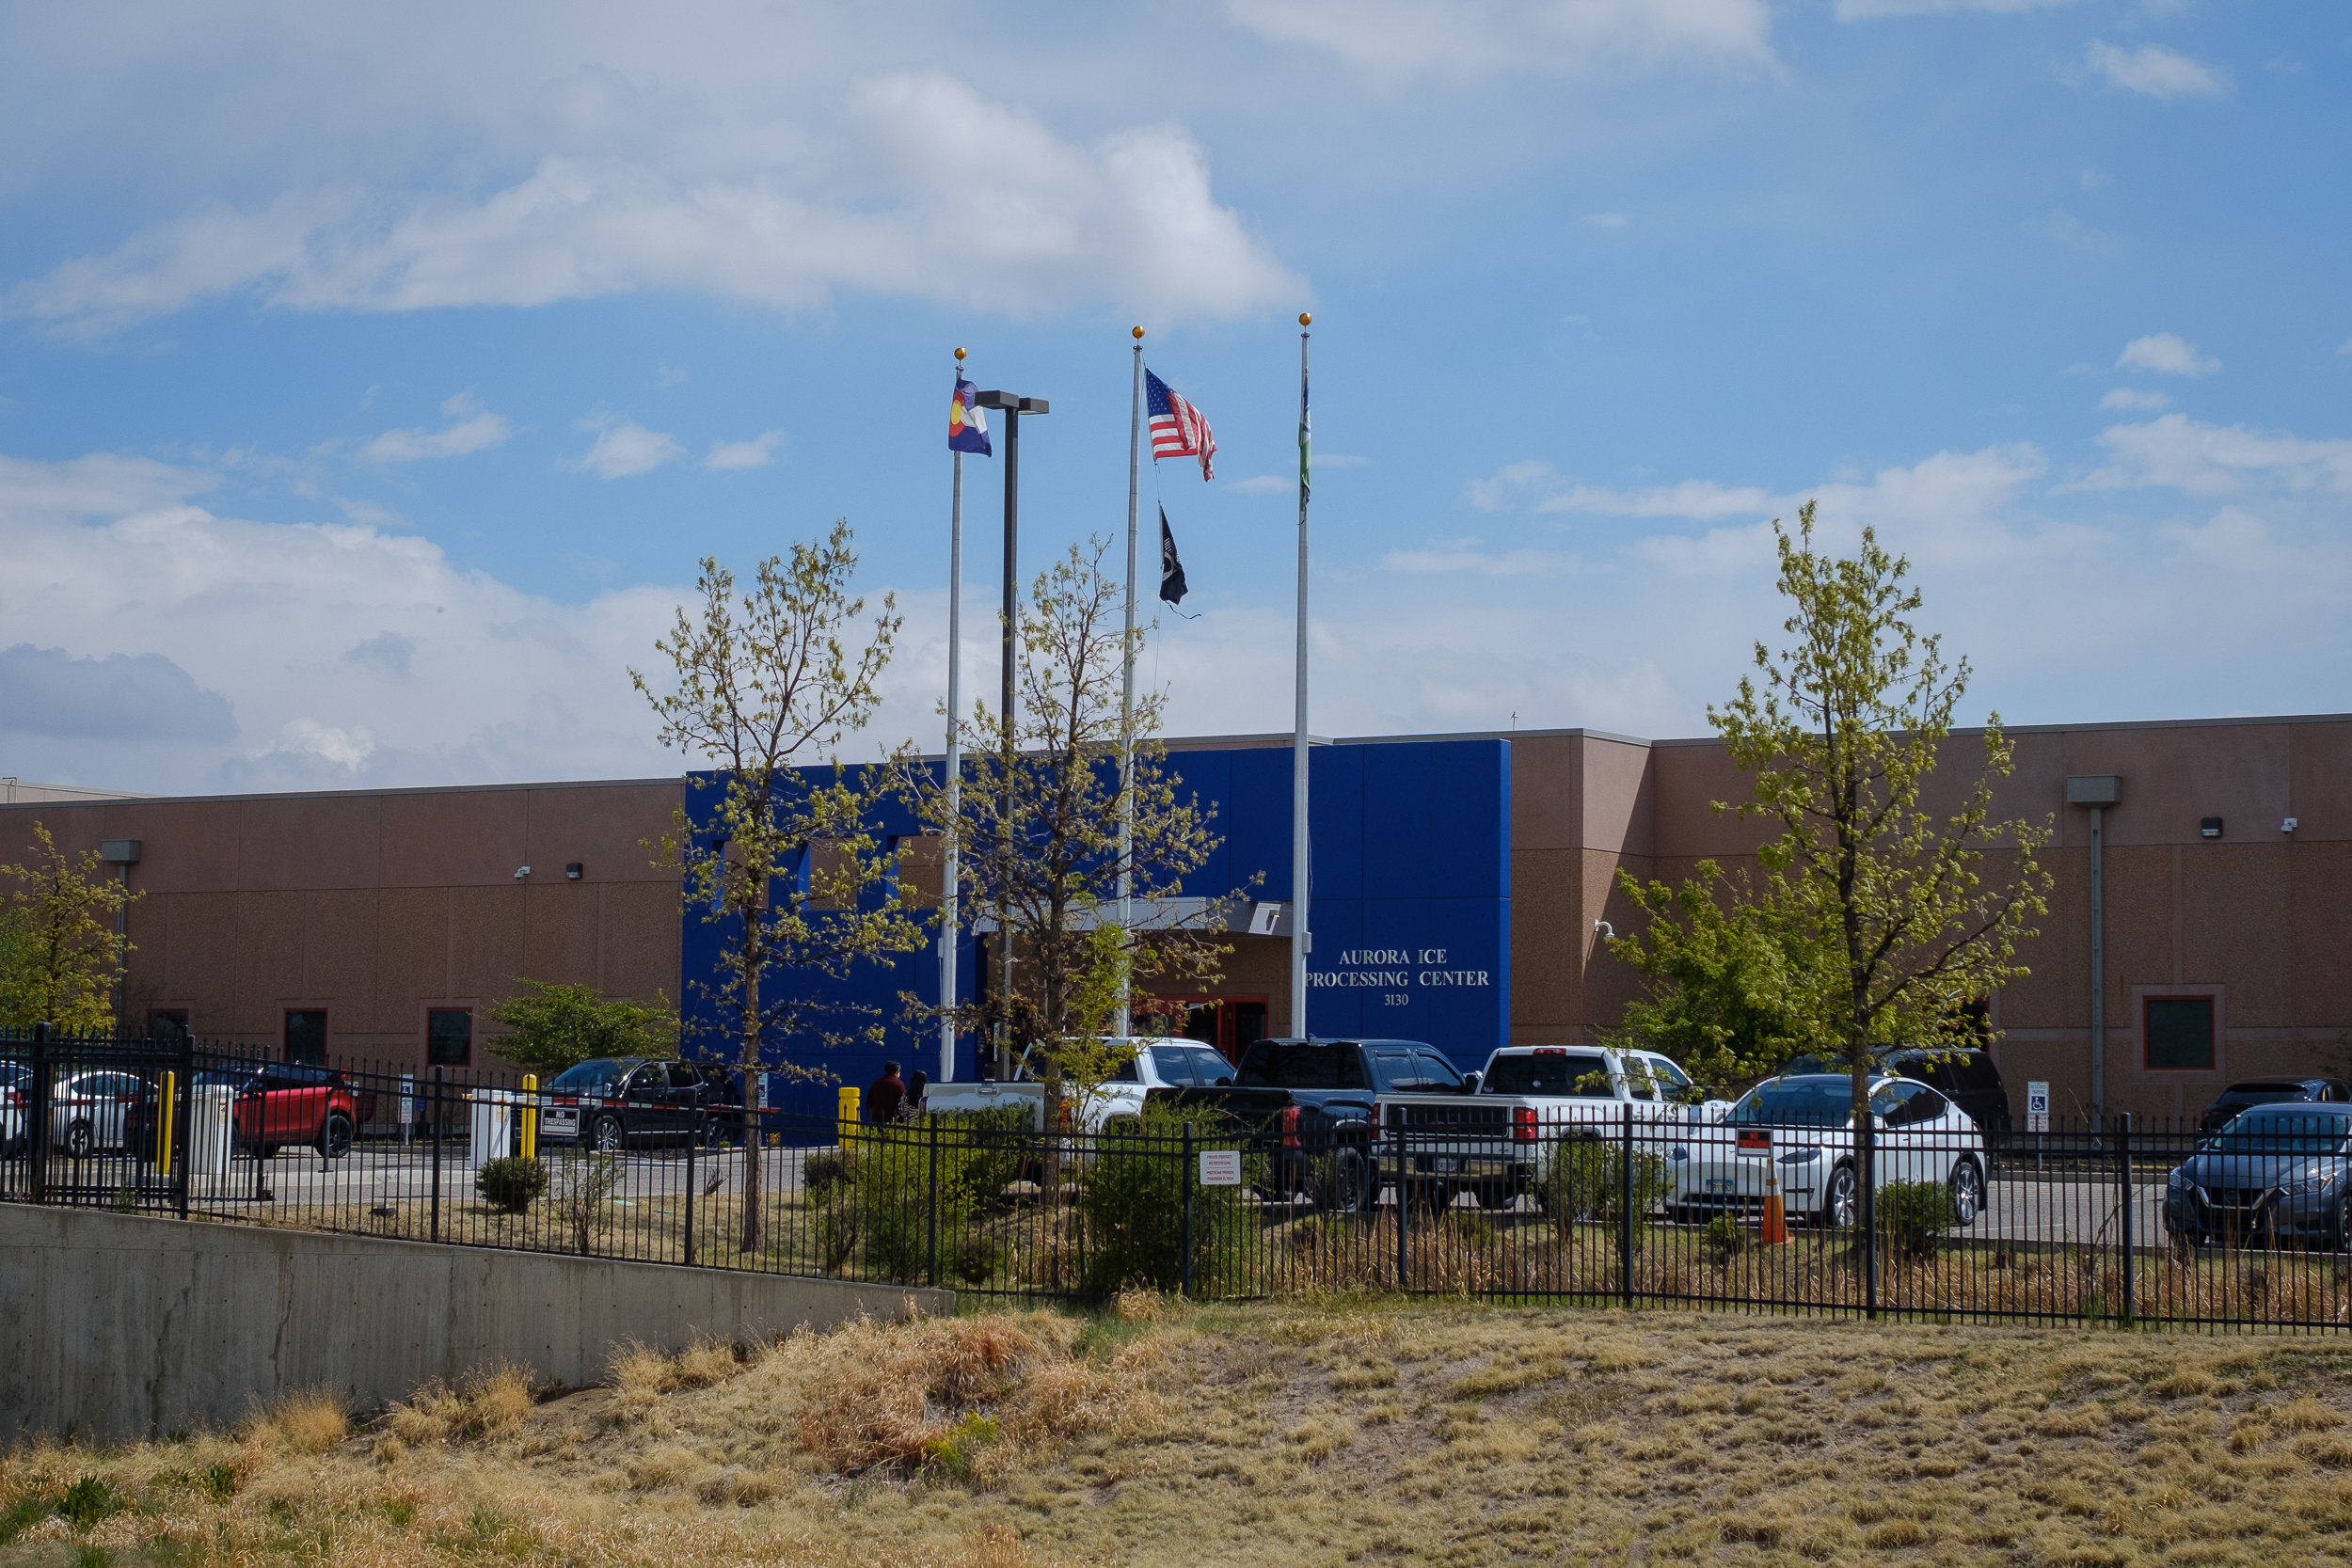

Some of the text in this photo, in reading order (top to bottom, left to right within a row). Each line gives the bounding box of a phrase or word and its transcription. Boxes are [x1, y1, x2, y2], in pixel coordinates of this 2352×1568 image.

[1339, 948, 1447, 965] AURORA ICE
[1306, 971, 1489, 987] PROCESSING CENTER
[1384, 993, 1409, 1006] 3130
[545, 1117, 576, 1126] TRESPASSING
